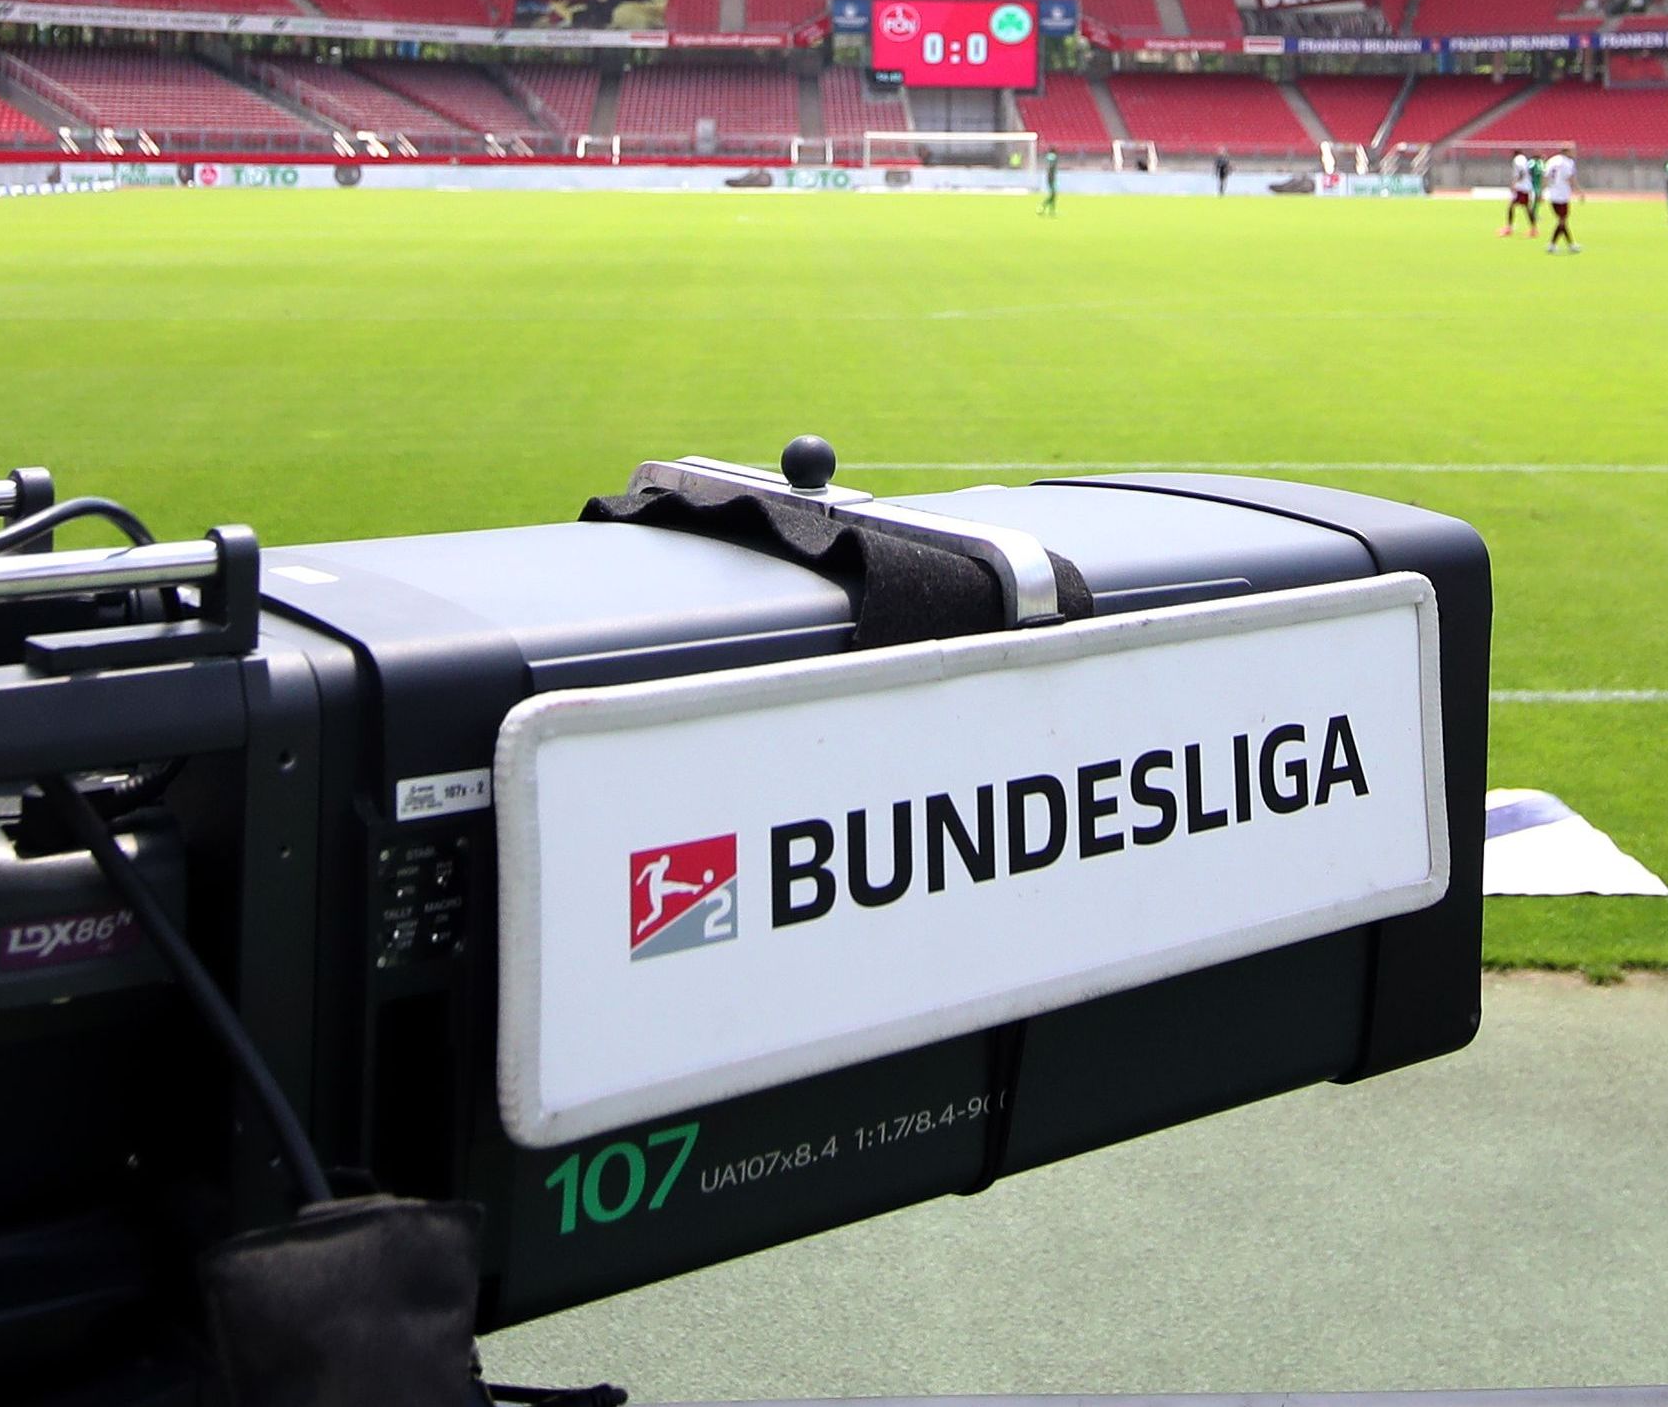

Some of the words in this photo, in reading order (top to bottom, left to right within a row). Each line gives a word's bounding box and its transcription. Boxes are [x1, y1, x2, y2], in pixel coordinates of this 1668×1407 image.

[923, 32, 988, 65] 0:0
[704, 888, 732, 938] 2
[770, 713, 1370, 930] BUNDESLIGA
[544, 1121, 701, 1235] 107
[699, 1135, 840, 1194] UA107x8.4
[853, 1088, 1007, 1153] 1:1.7/8.4-9
